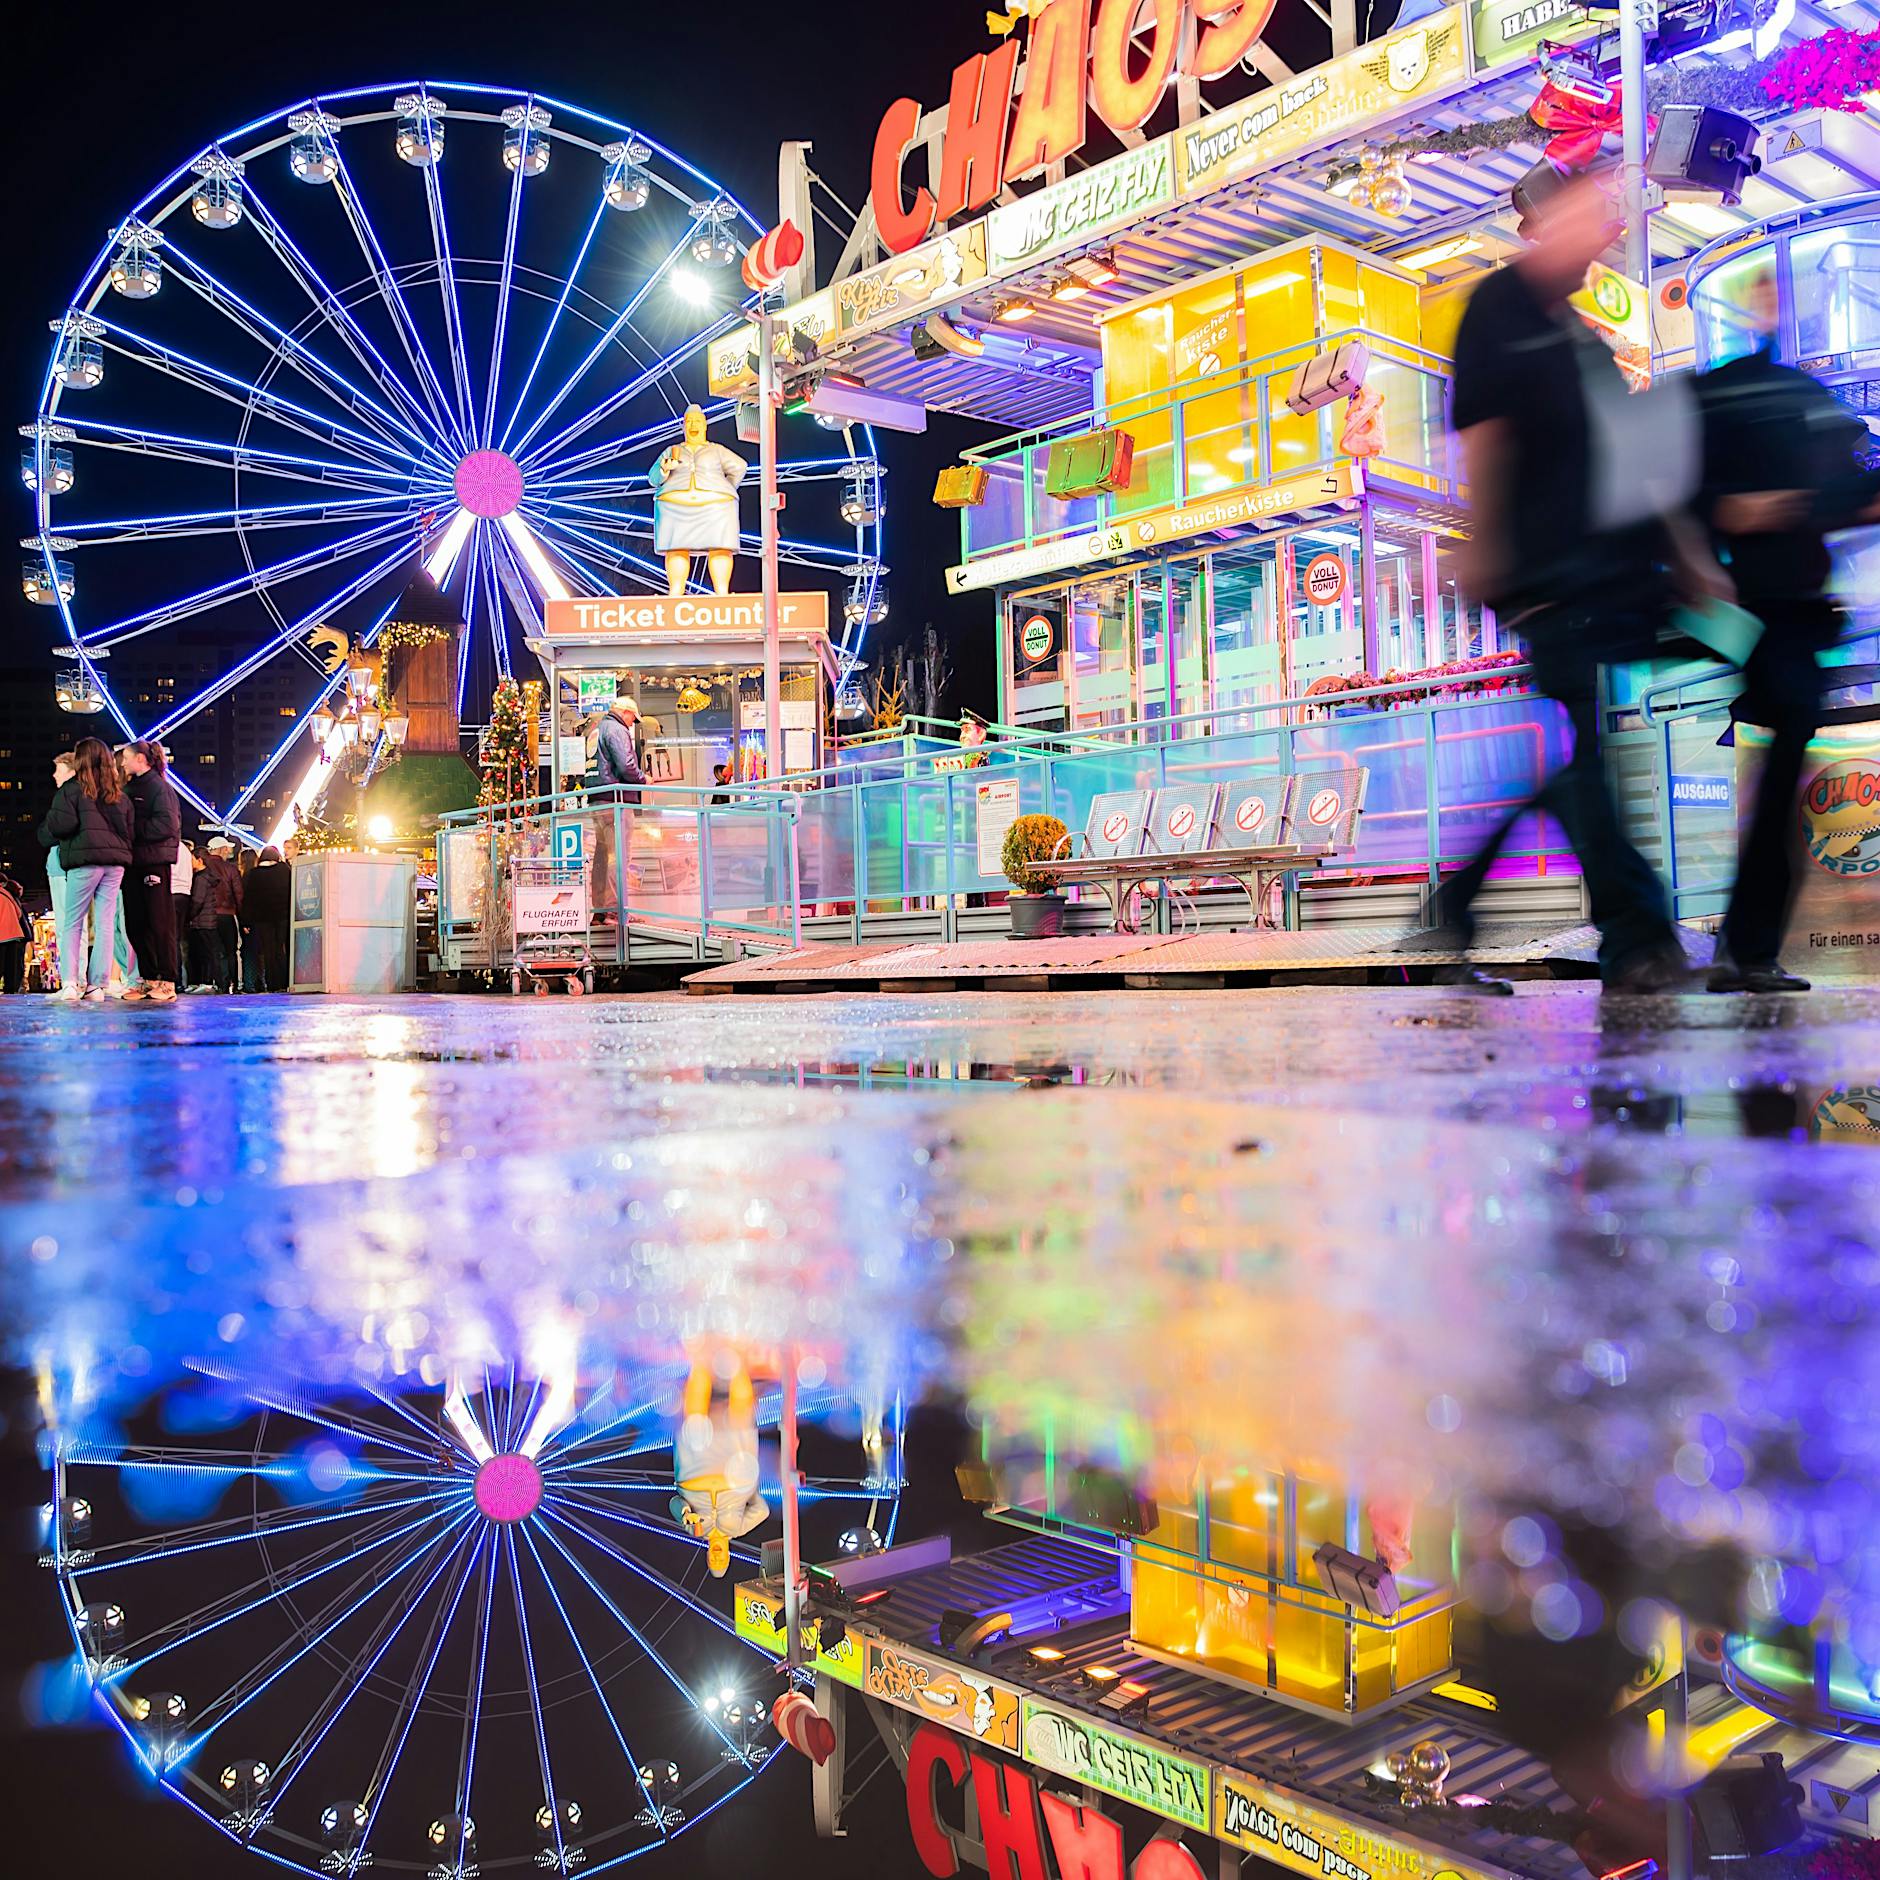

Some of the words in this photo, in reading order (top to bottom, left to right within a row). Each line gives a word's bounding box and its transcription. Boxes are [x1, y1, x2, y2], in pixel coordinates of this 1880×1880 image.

[1186, 124, 1238, 181] Never
[1240, 102, 1280, 144] com
[1280, 76, 1329, 118] back
[1019, 203, 1057, 253] MC
[1060, 176, 1118, 235] GEIZ
[1121, 157, 1165, 209] FLY
[839, 275, 883, 309] Kiss
[852, 286, 899, 327] Air
[1170, 488, 1294, 533] Raucherkiste
[1313, 567, 1337, 579] VOLL
[1312, 580, 1338, 592] DONUT
[573, 603, 665, 629] Ticket
[674, 601, 798, 627] Countr
[1027, 627, 1045, 637] VOLL
[1026, 639, 1047, 651] DONUT
[1673, 783, 1729, 800] AUSGANG
[1808, 772, 1880, 815] CHAO
[561, 829, 578, 874] P
[522, 909, 579, 918] FLUGHAFEN
[541, 919, 579, 927] ERFURT
[1810, 932, 1828, 948] Für
[1831, 932, 1864, 947] einen
